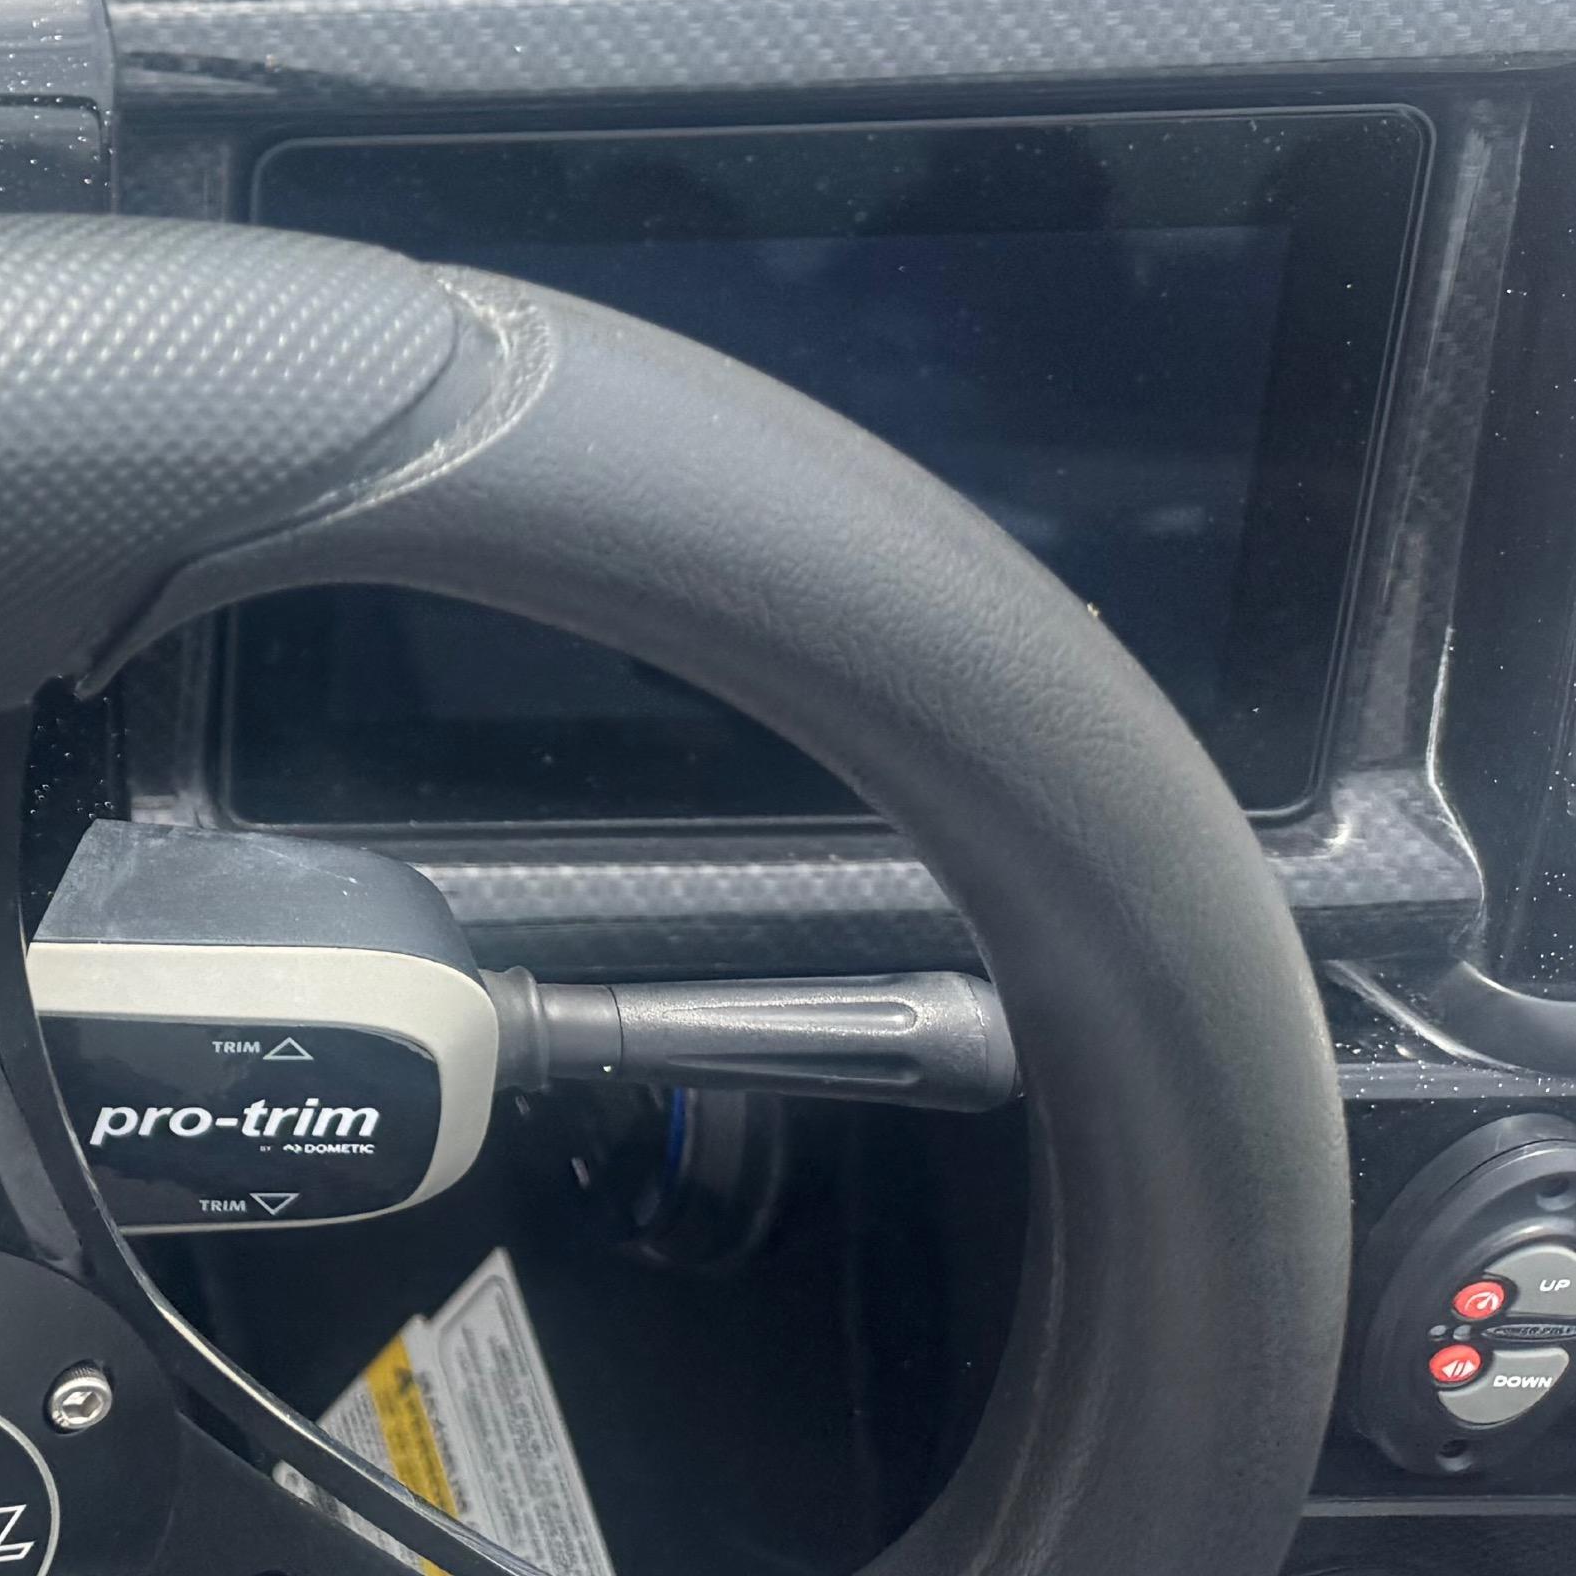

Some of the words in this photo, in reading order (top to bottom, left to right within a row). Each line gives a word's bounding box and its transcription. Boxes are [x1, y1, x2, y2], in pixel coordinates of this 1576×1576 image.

[212, 1040, 262, 1055] TRIM
[89, 1097, 380, 1146] pro-trim
[303, 1143, 376, 1155] DOMETIC
[199, 1199, 247, 1214] TRIM
[1538, 1278, 1572, 1293] UP
[1492, 1374, 1553, 1389] DOWN
